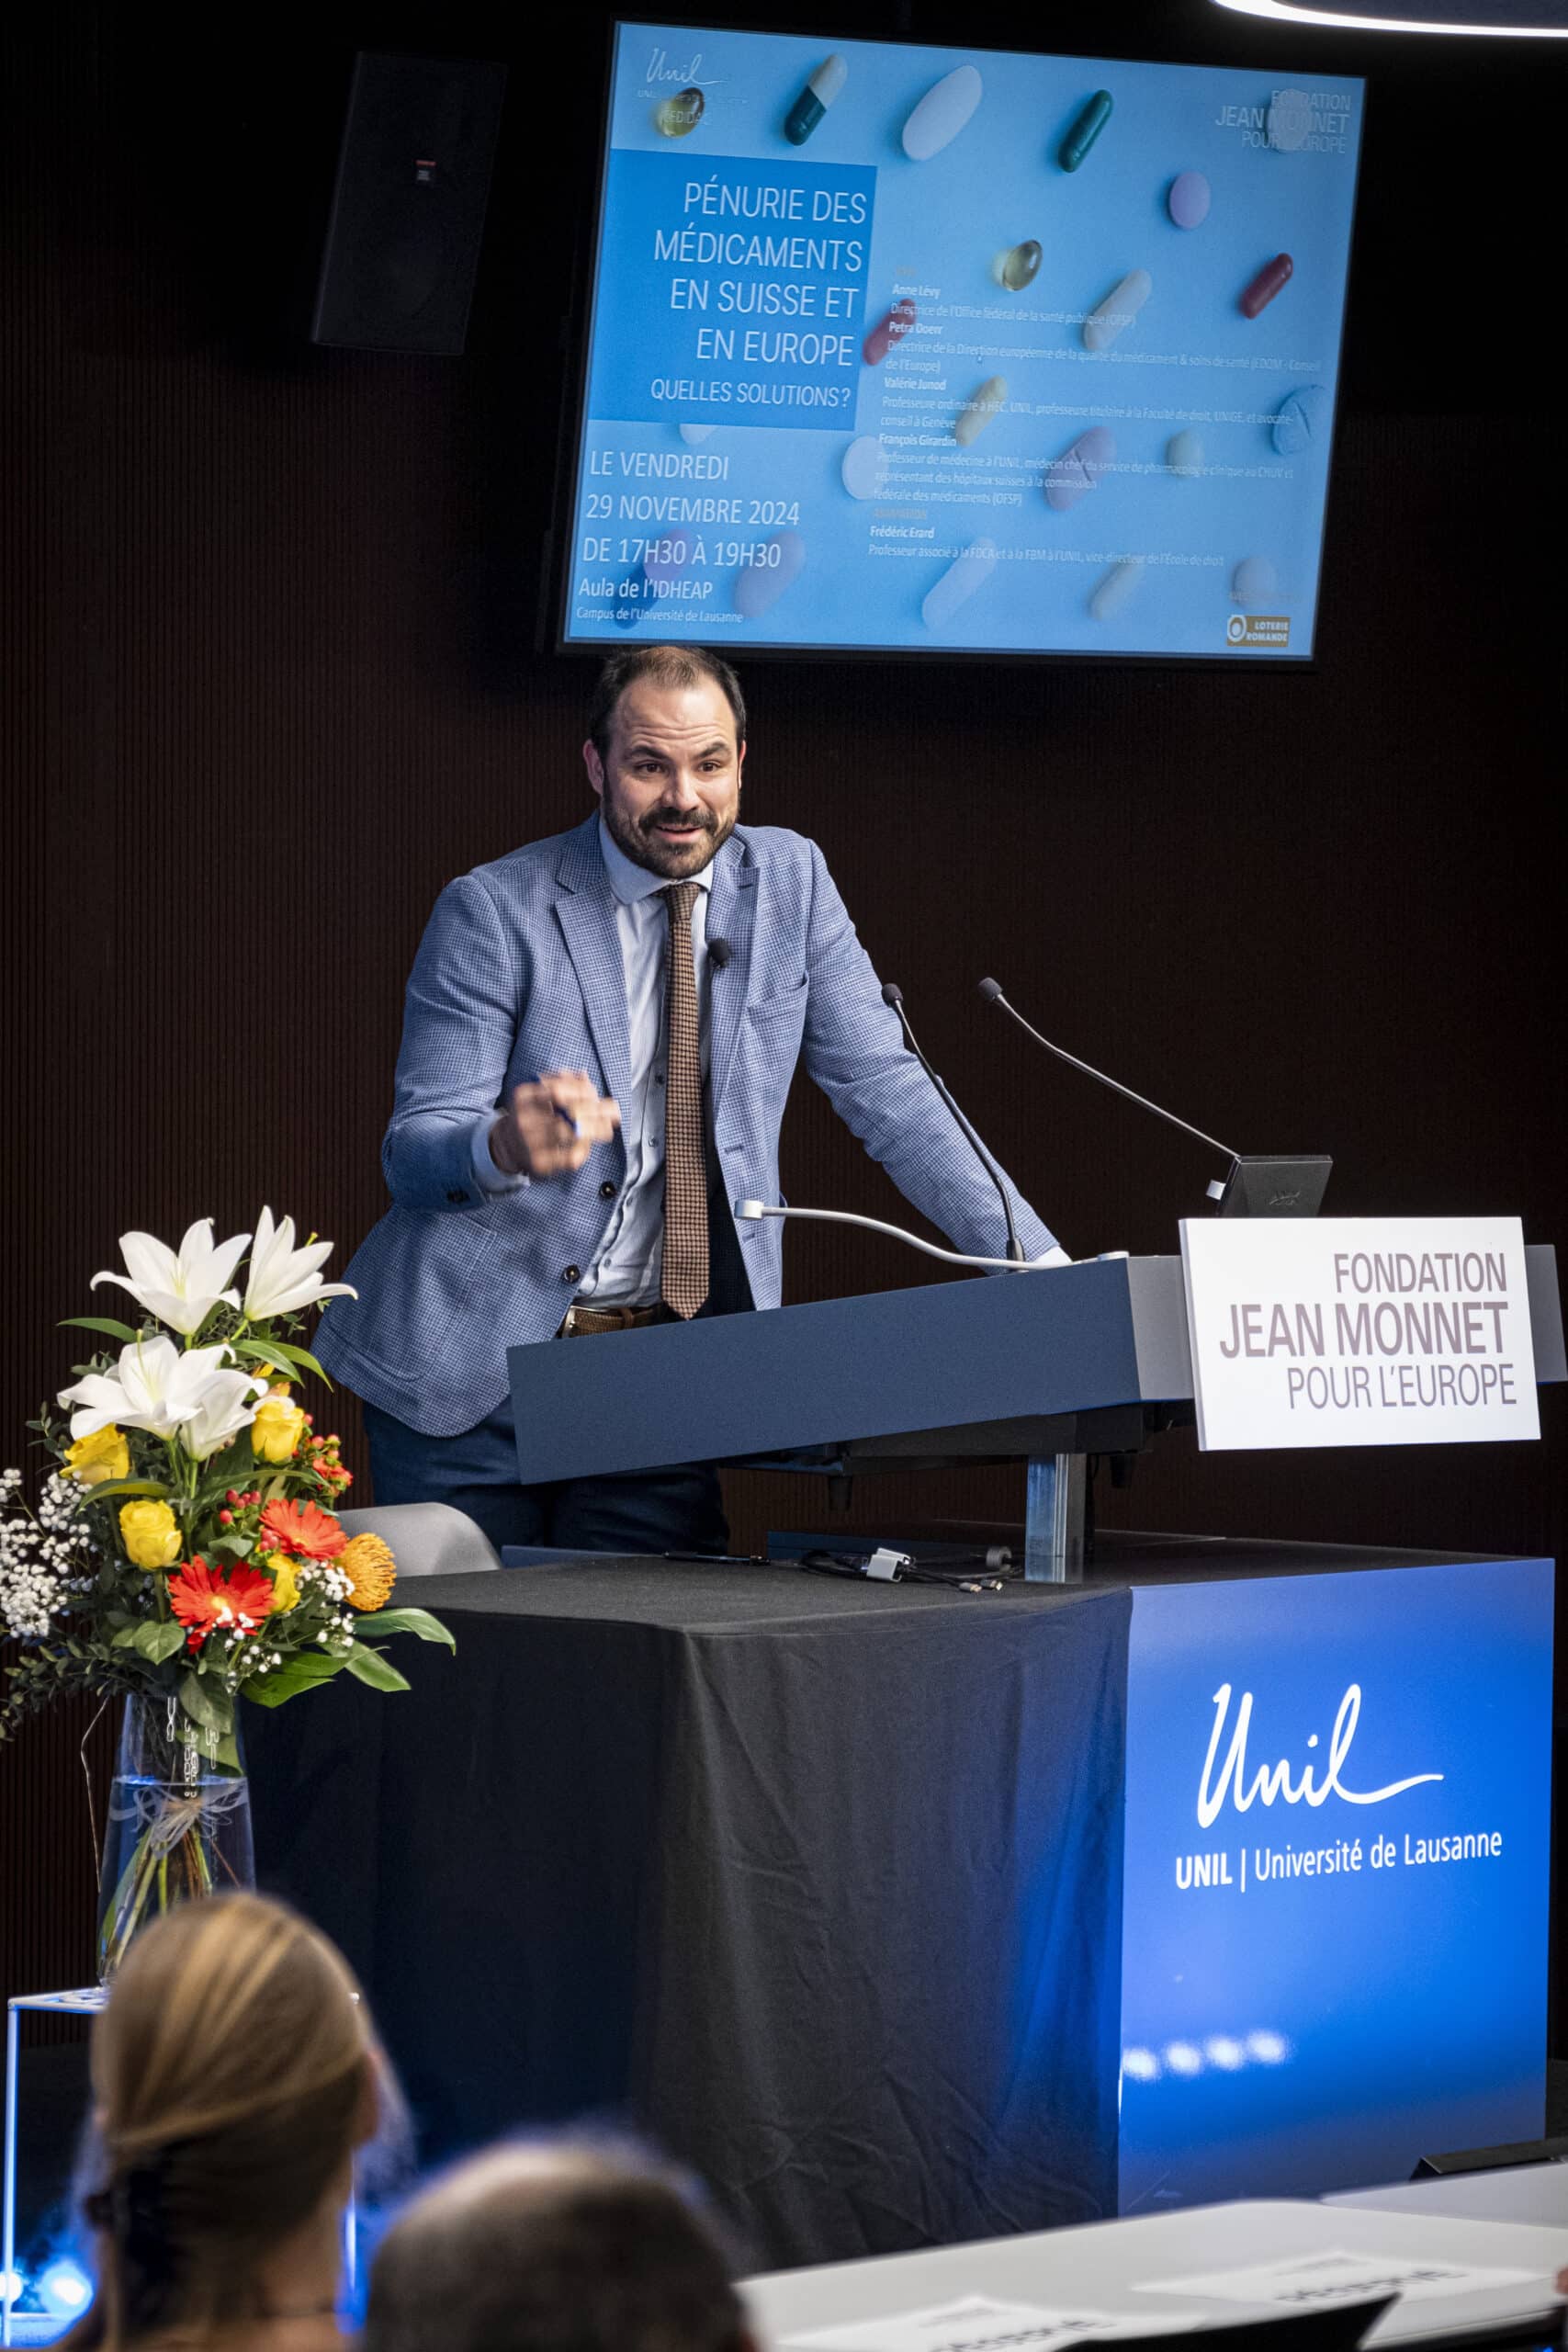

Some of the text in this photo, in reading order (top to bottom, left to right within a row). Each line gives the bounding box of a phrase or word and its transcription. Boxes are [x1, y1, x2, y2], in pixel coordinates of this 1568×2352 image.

[1270, 89, 1351, 111] FODATION
[1213, 105, 1265, 129] JEAN
[683, 174, 867, 224] PÉNURIE DES
[654, 220, 863, 273] MÉDICAMENTS
[670, 278, 860, 319] EN SUISSE ET
[892, 284, 942, 299] Anne Lévy
[888, 322, 914, 334] Petra
[695, 327, 854, 367] EN EUROPE
[650, 378, 732, 403] QUELLES
[885, 376, 947, 390] Valérie Junod
[879, 433, 956, 447] François Girardin
[589, 450, 729, 481] LE VENDREDI
[585, 493, 800, 526] 29 NOVEMBRE 2024
[870, 525, 908, 538] Frédéric
[582, 532, 782, 569] DE 17H30 À 19H30
[579, 578, 713, 600] Aula de l'IDHEAP
[576, 606, 744, 624] Campus de l'Université de Lausanne
[1334, 1252, 1507, 1294] FONDATION
[1219, 1301, 1508, 1359] JEAN MONNET
[1287, 1363, 1517, 1410] POUR L'EUROPE
[1197, 1682, 1445, 1829] Unil
[1176, 1830, 1503, 1890] UNIL Université de Lausanne
